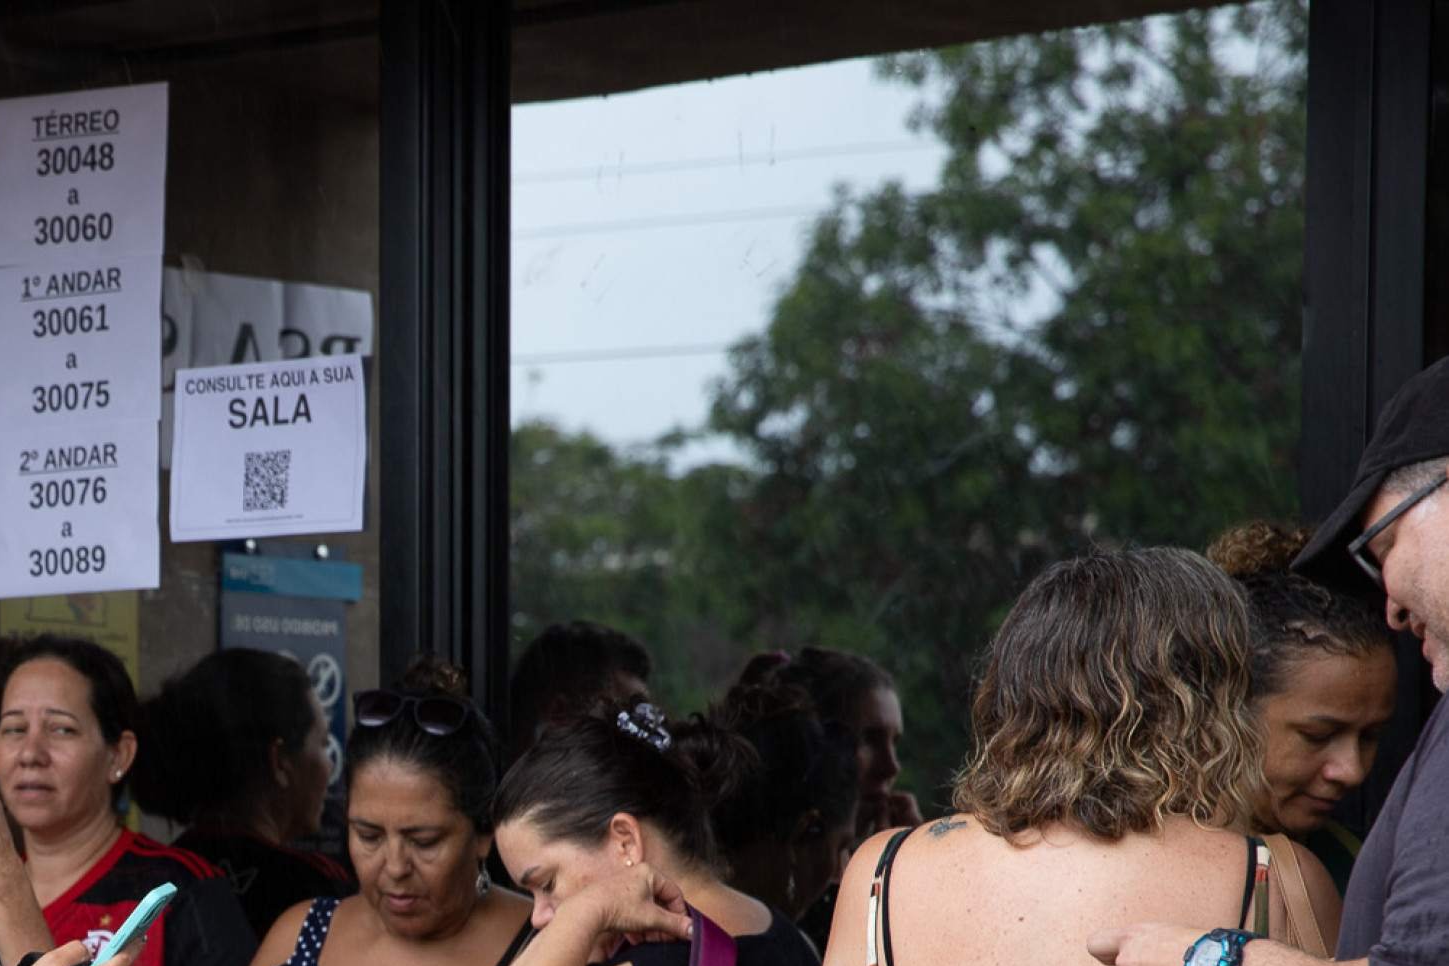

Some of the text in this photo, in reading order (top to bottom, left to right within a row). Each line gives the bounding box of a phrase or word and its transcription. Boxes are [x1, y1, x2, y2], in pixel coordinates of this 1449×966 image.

[33, 109, 119, 136] TÉRREO
[37, 143, 114, 176] 30048
[68, 188, 78, 205] a
[35, 213, 113, 245] 30060
[46, 268, 120, 293] ANDAR
[34, 304, 109, 337] 30061
[66, 353, 77, 369] a
[185, 366, 354, 395] CONSULTE AQUI A SUA
[33, 380, 109, 413] 30075
[229, 394, 311, 429] SALA
[44, 443, 117, 467] ANDAR
[30, 477, 106, 509] 30076
[62, 522, 72, 537] a
[30, 545, 105, 577] 30089
